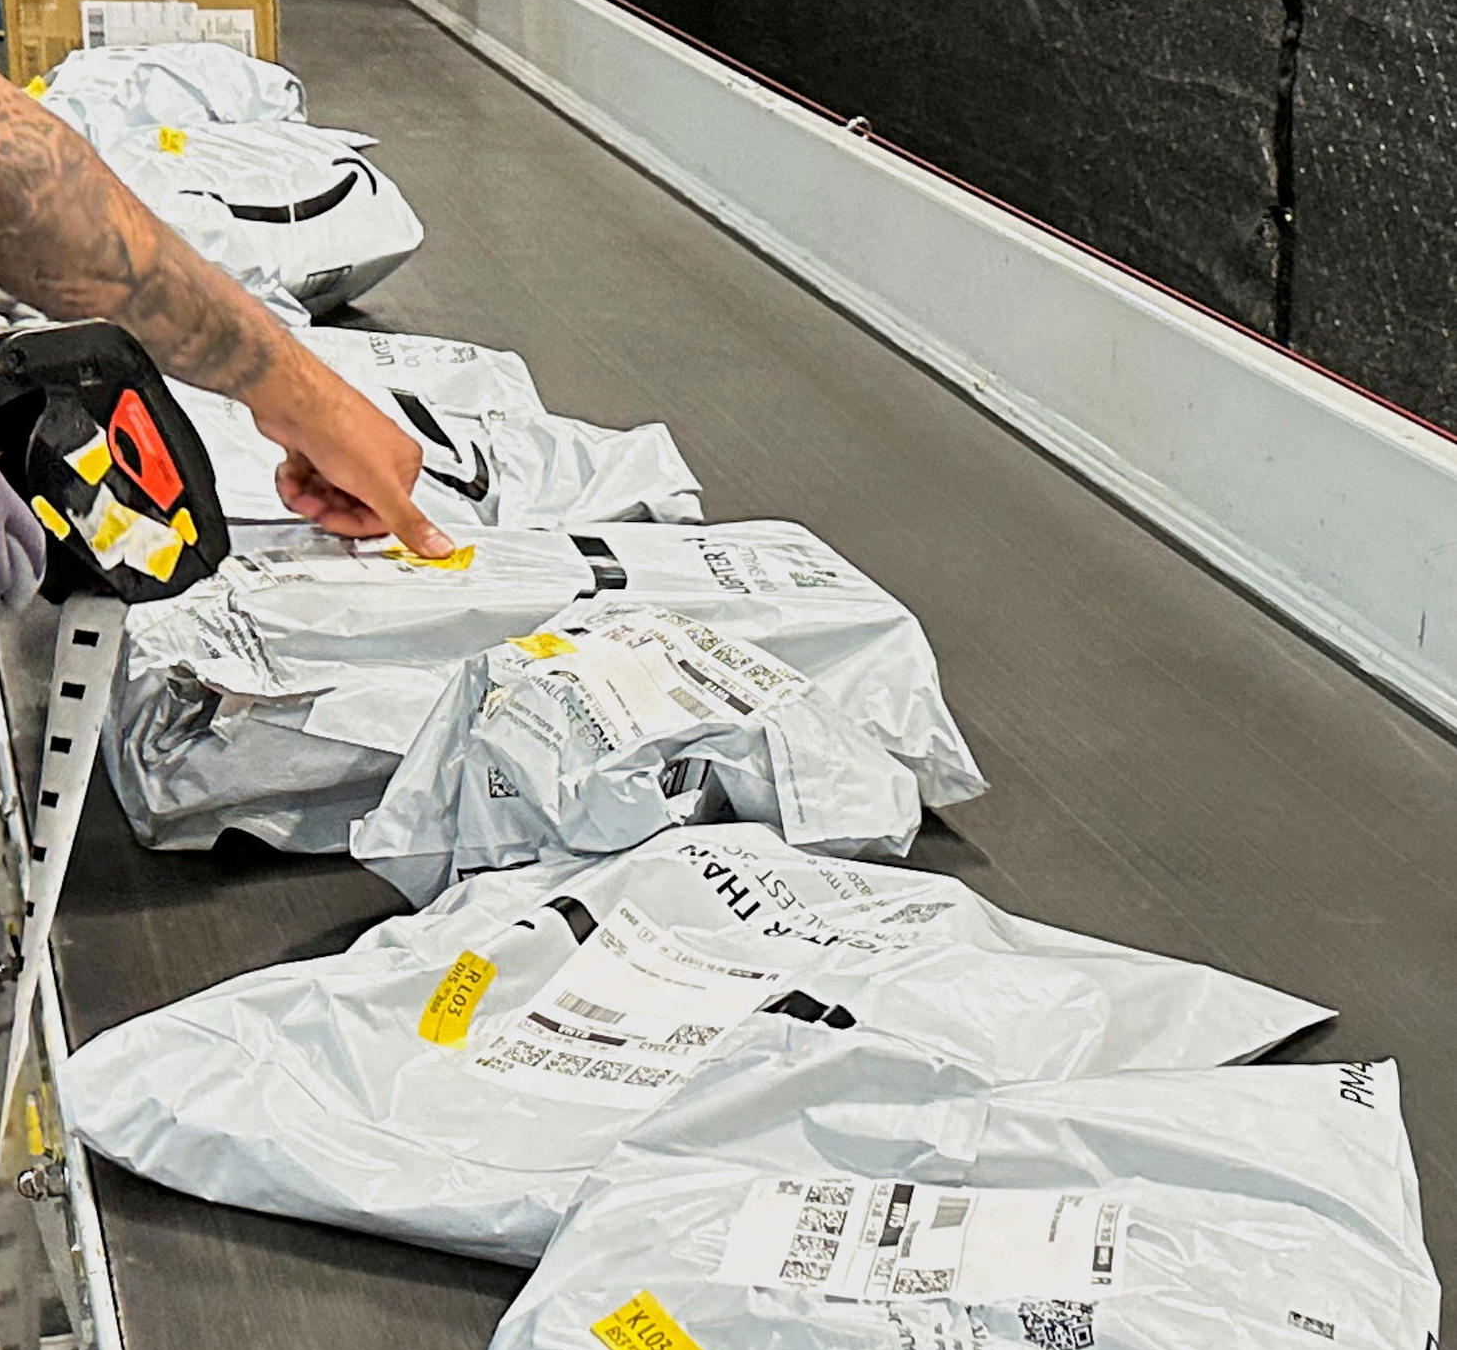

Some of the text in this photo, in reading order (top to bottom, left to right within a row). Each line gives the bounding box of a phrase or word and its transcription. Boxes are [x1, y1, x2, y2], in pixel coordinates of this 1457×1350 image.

[446, 968, 483, 1018] R L03
[625, 1308, 650, 1331] K
